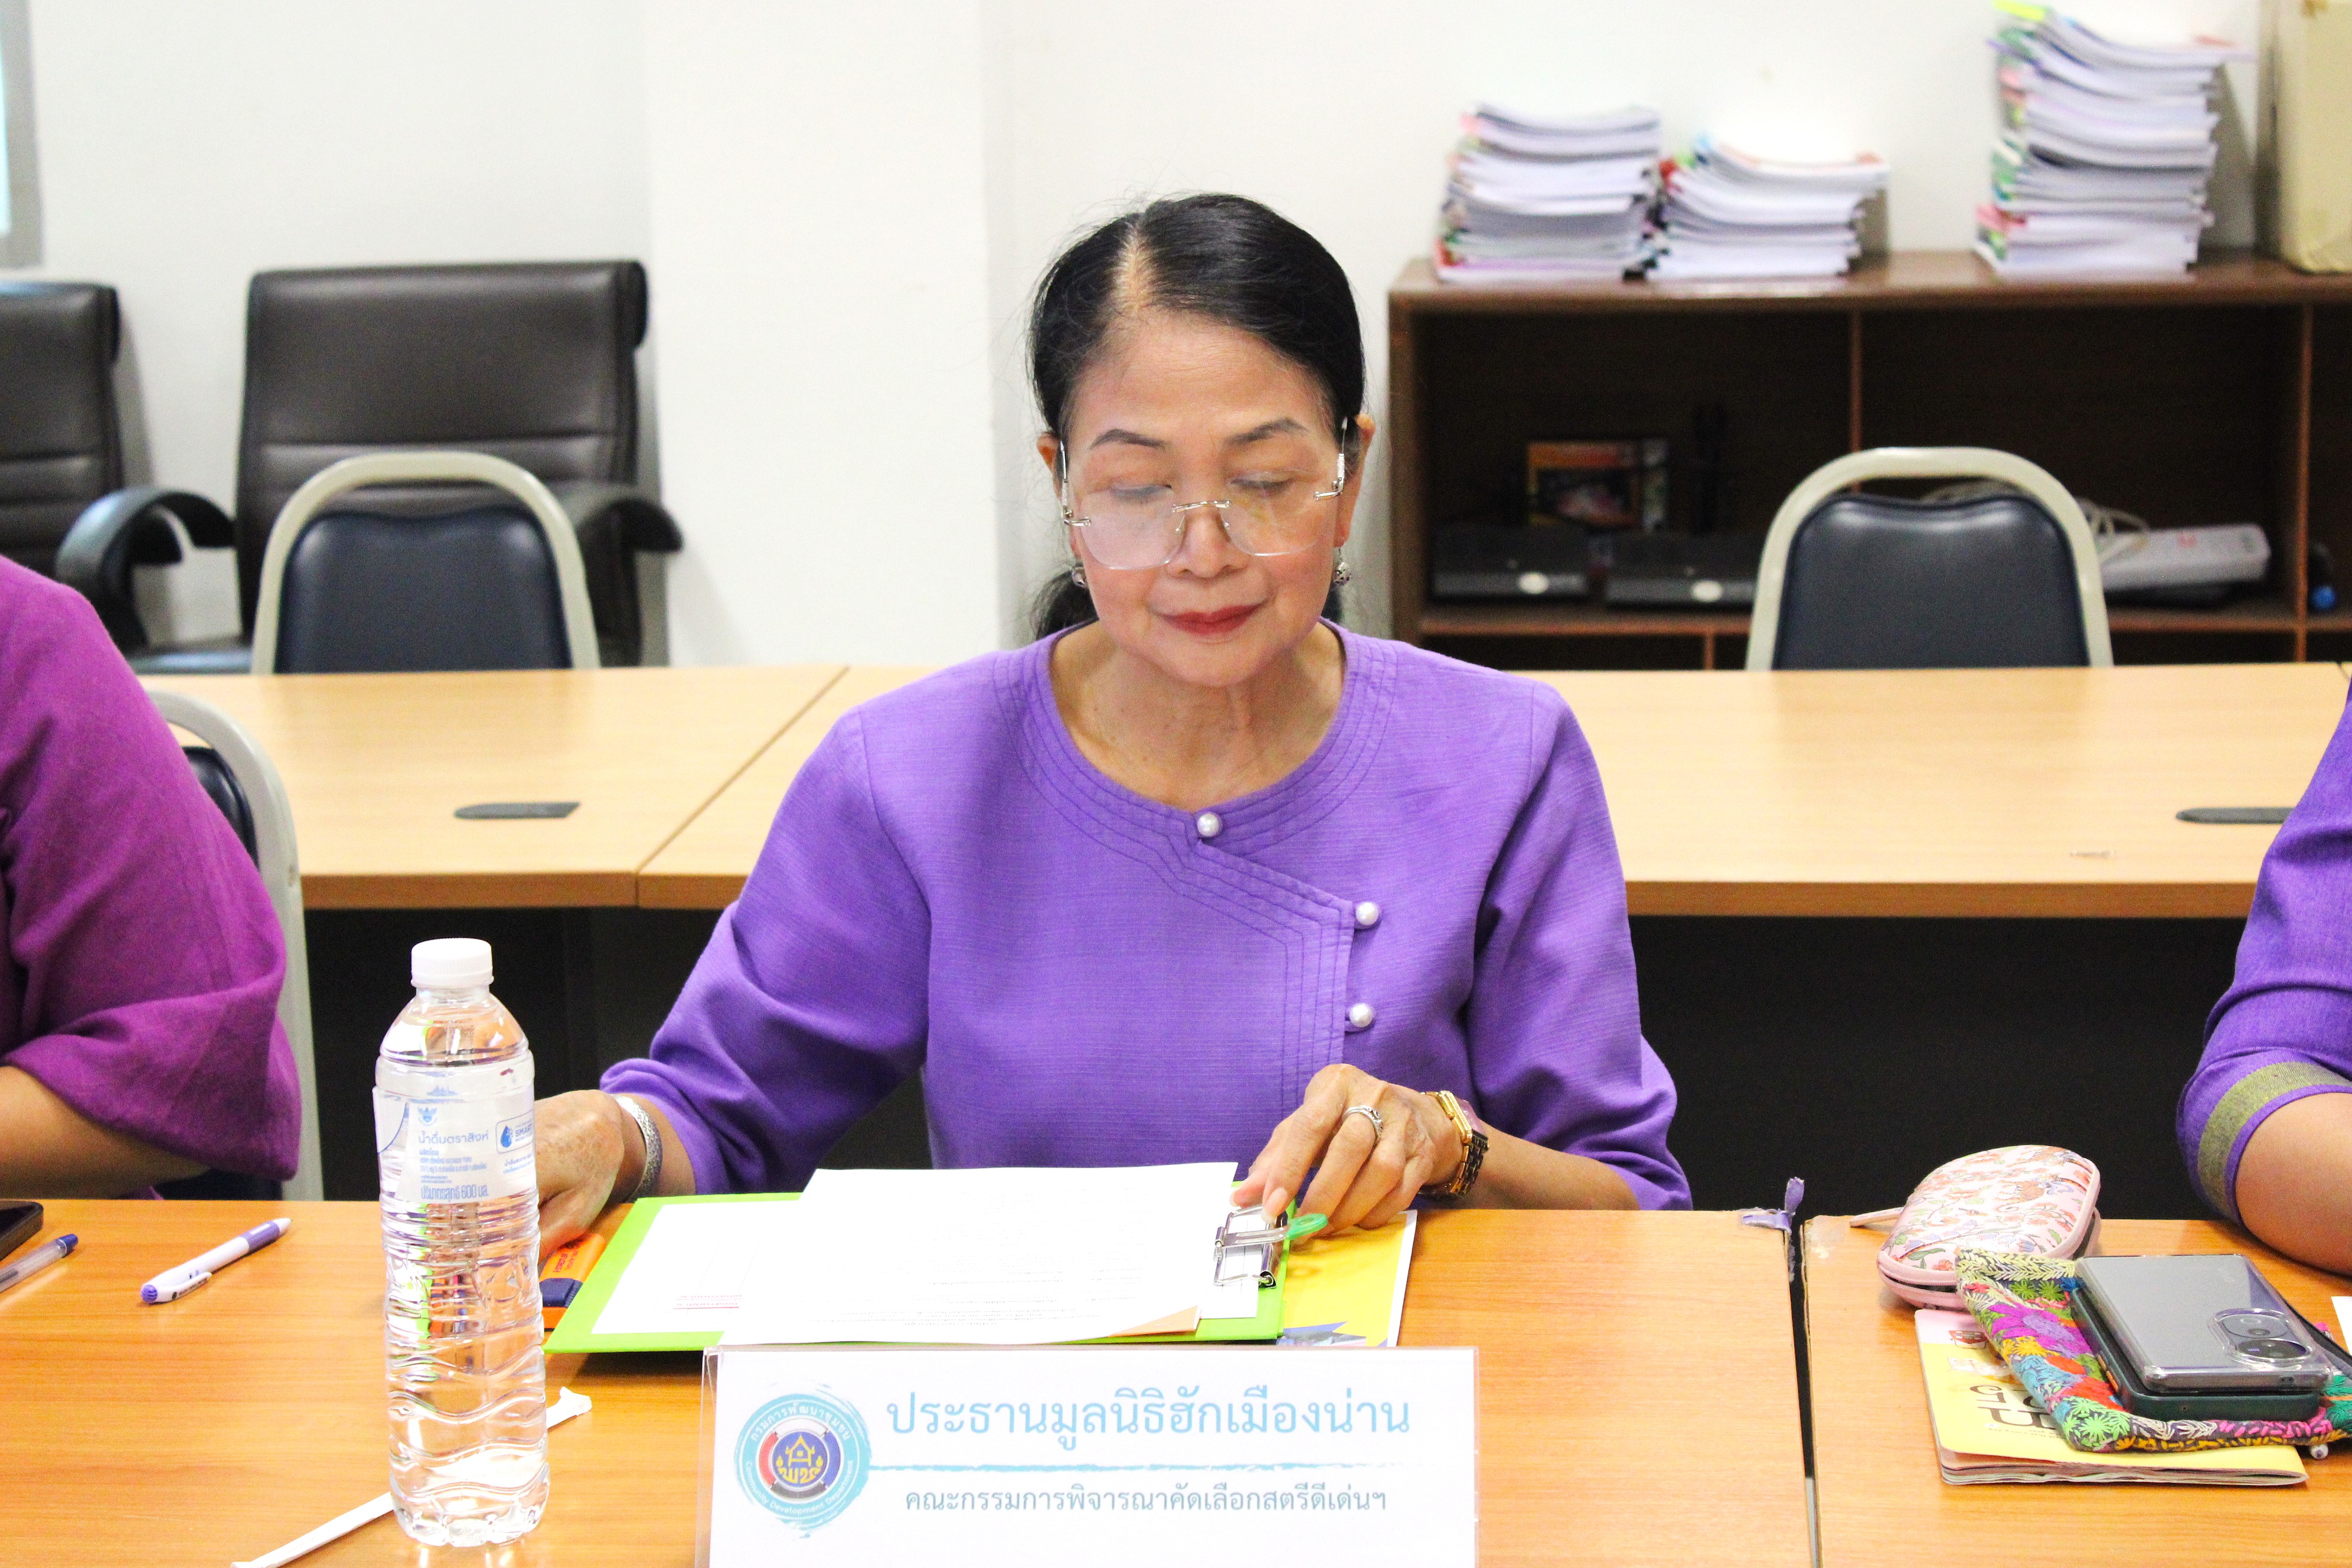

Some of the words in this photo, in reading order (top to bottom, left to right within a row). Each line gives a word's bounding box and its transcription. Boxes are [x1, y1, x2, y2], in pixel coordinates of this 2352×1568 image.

[460, 1184, 477, 1200] 600
[886, 1384, 1410, 1451] ประธานมูลนิธิฮักเมืองน่าน
[745, 1461, 769, 1504] Community
[770, 1501, 824, 1515] Development
[826, 1460, 854, 1505] Department
[906, 1482, 1387, 1511] คณะกรรมการพิจารณาคัดเลือกสตรีดีเด่นฯ
